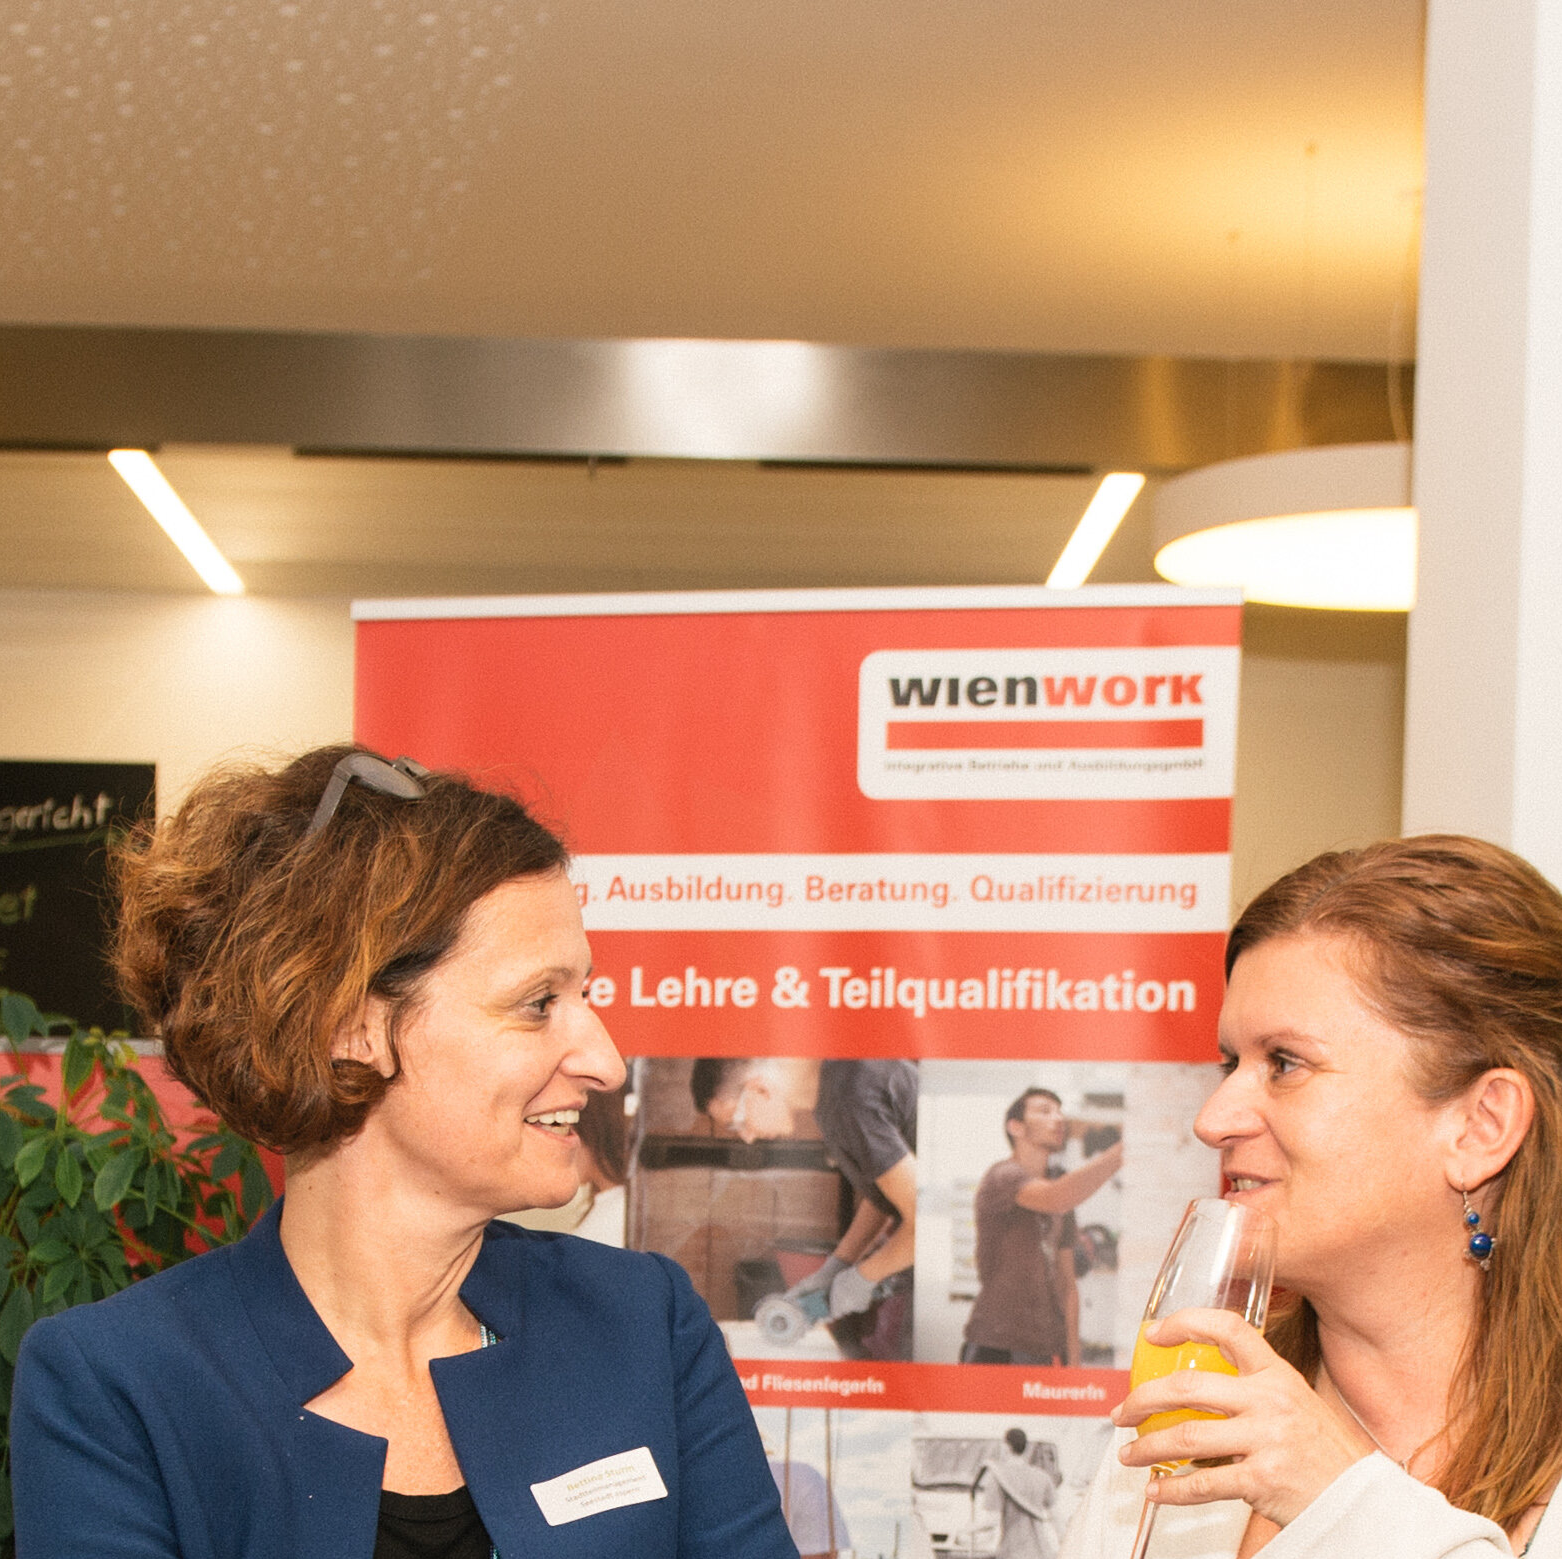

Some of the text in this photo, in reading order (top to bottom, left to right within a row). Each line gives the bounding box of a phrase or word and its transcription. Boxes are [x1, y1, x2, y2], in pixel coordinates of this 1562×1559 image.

[888, 673, 1204, 708] wienwork
[606, 876, 793, 909] Ausbildung.
[805, 876, 959, 910] Beratung.
[970, 875, 1198, 910] Qualifizierung
[630, 966, 758, 1008] Lehre
[771, 966, 810, 1009] &
[819, 967, 1196, 1018] Teilqualifikation
